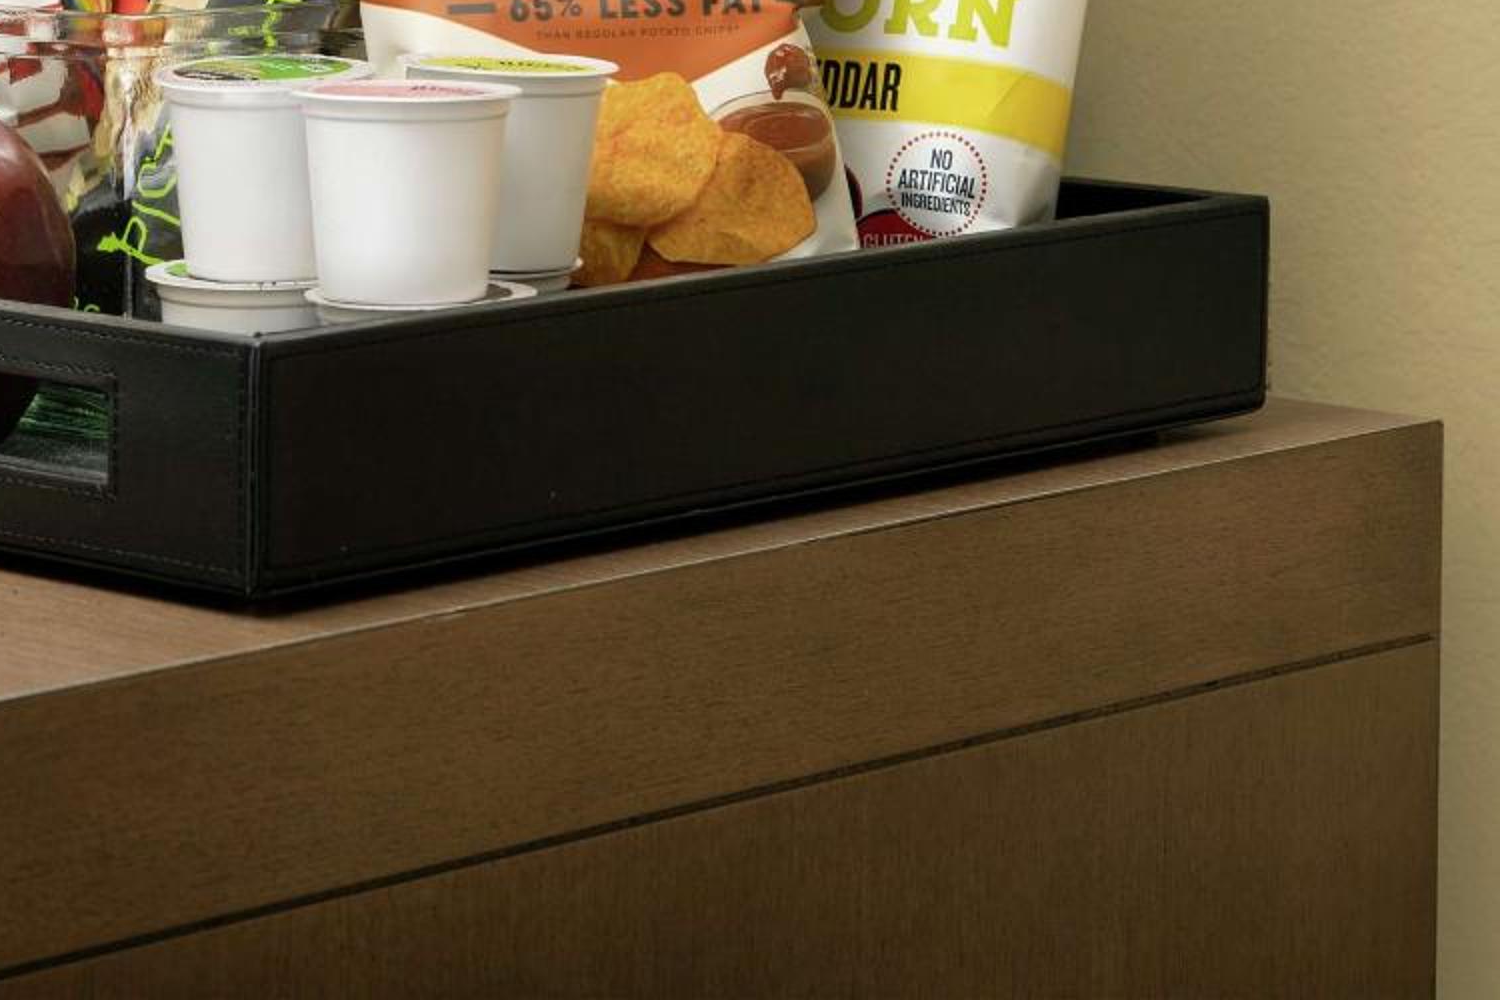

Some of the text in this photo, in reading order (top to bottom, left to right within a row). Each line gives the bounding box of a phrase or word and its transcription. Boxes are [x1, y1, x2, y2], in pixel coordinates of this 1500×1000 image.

[815, 58, 902, 112] DDAR
[930, 148, 953, 170] NO
[898, 169, 976, 199] ARTIFICIAL
[901, 191, 971, 216] INGREDIENTS
